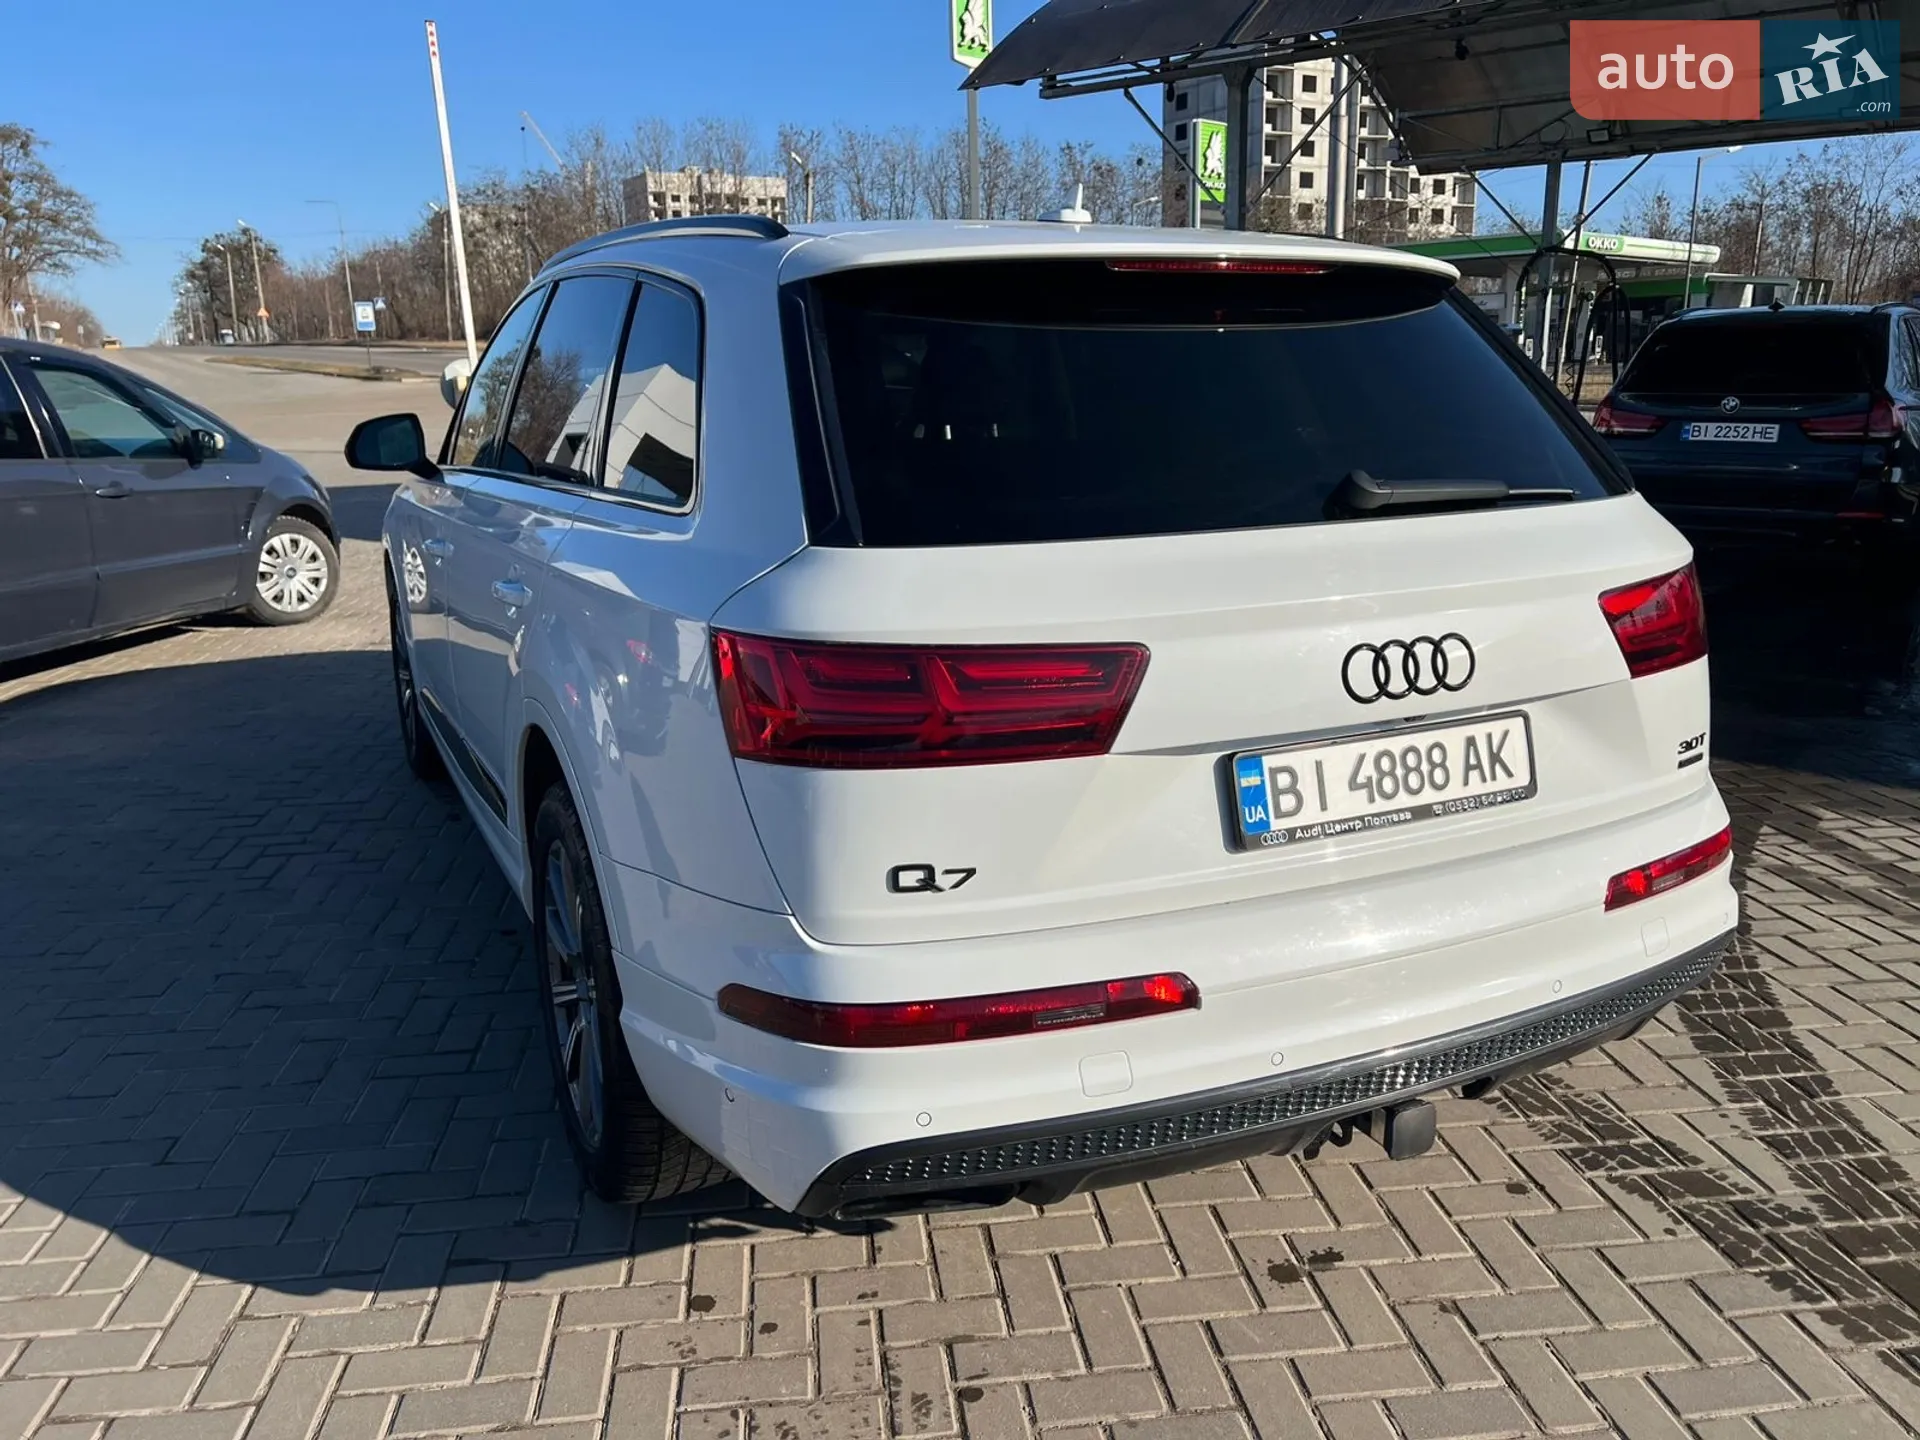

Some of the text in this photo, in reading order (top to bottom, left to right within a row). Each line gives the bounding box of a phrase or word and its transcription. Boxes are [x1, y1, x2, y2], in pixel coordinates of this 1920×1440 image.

[1588, 236, 1619, 250] OKKO
[1691, 425, 1776, 440] BI 2252 HE
[1268, 729, 1515, 819] BI 4888 AK
[1244, 805, 1267, 823] UA
[1325, 820, 1363, 834] Центр
[1364, 811, 1412, 827] Полтава
[885, 863, 977, 893] Q7
